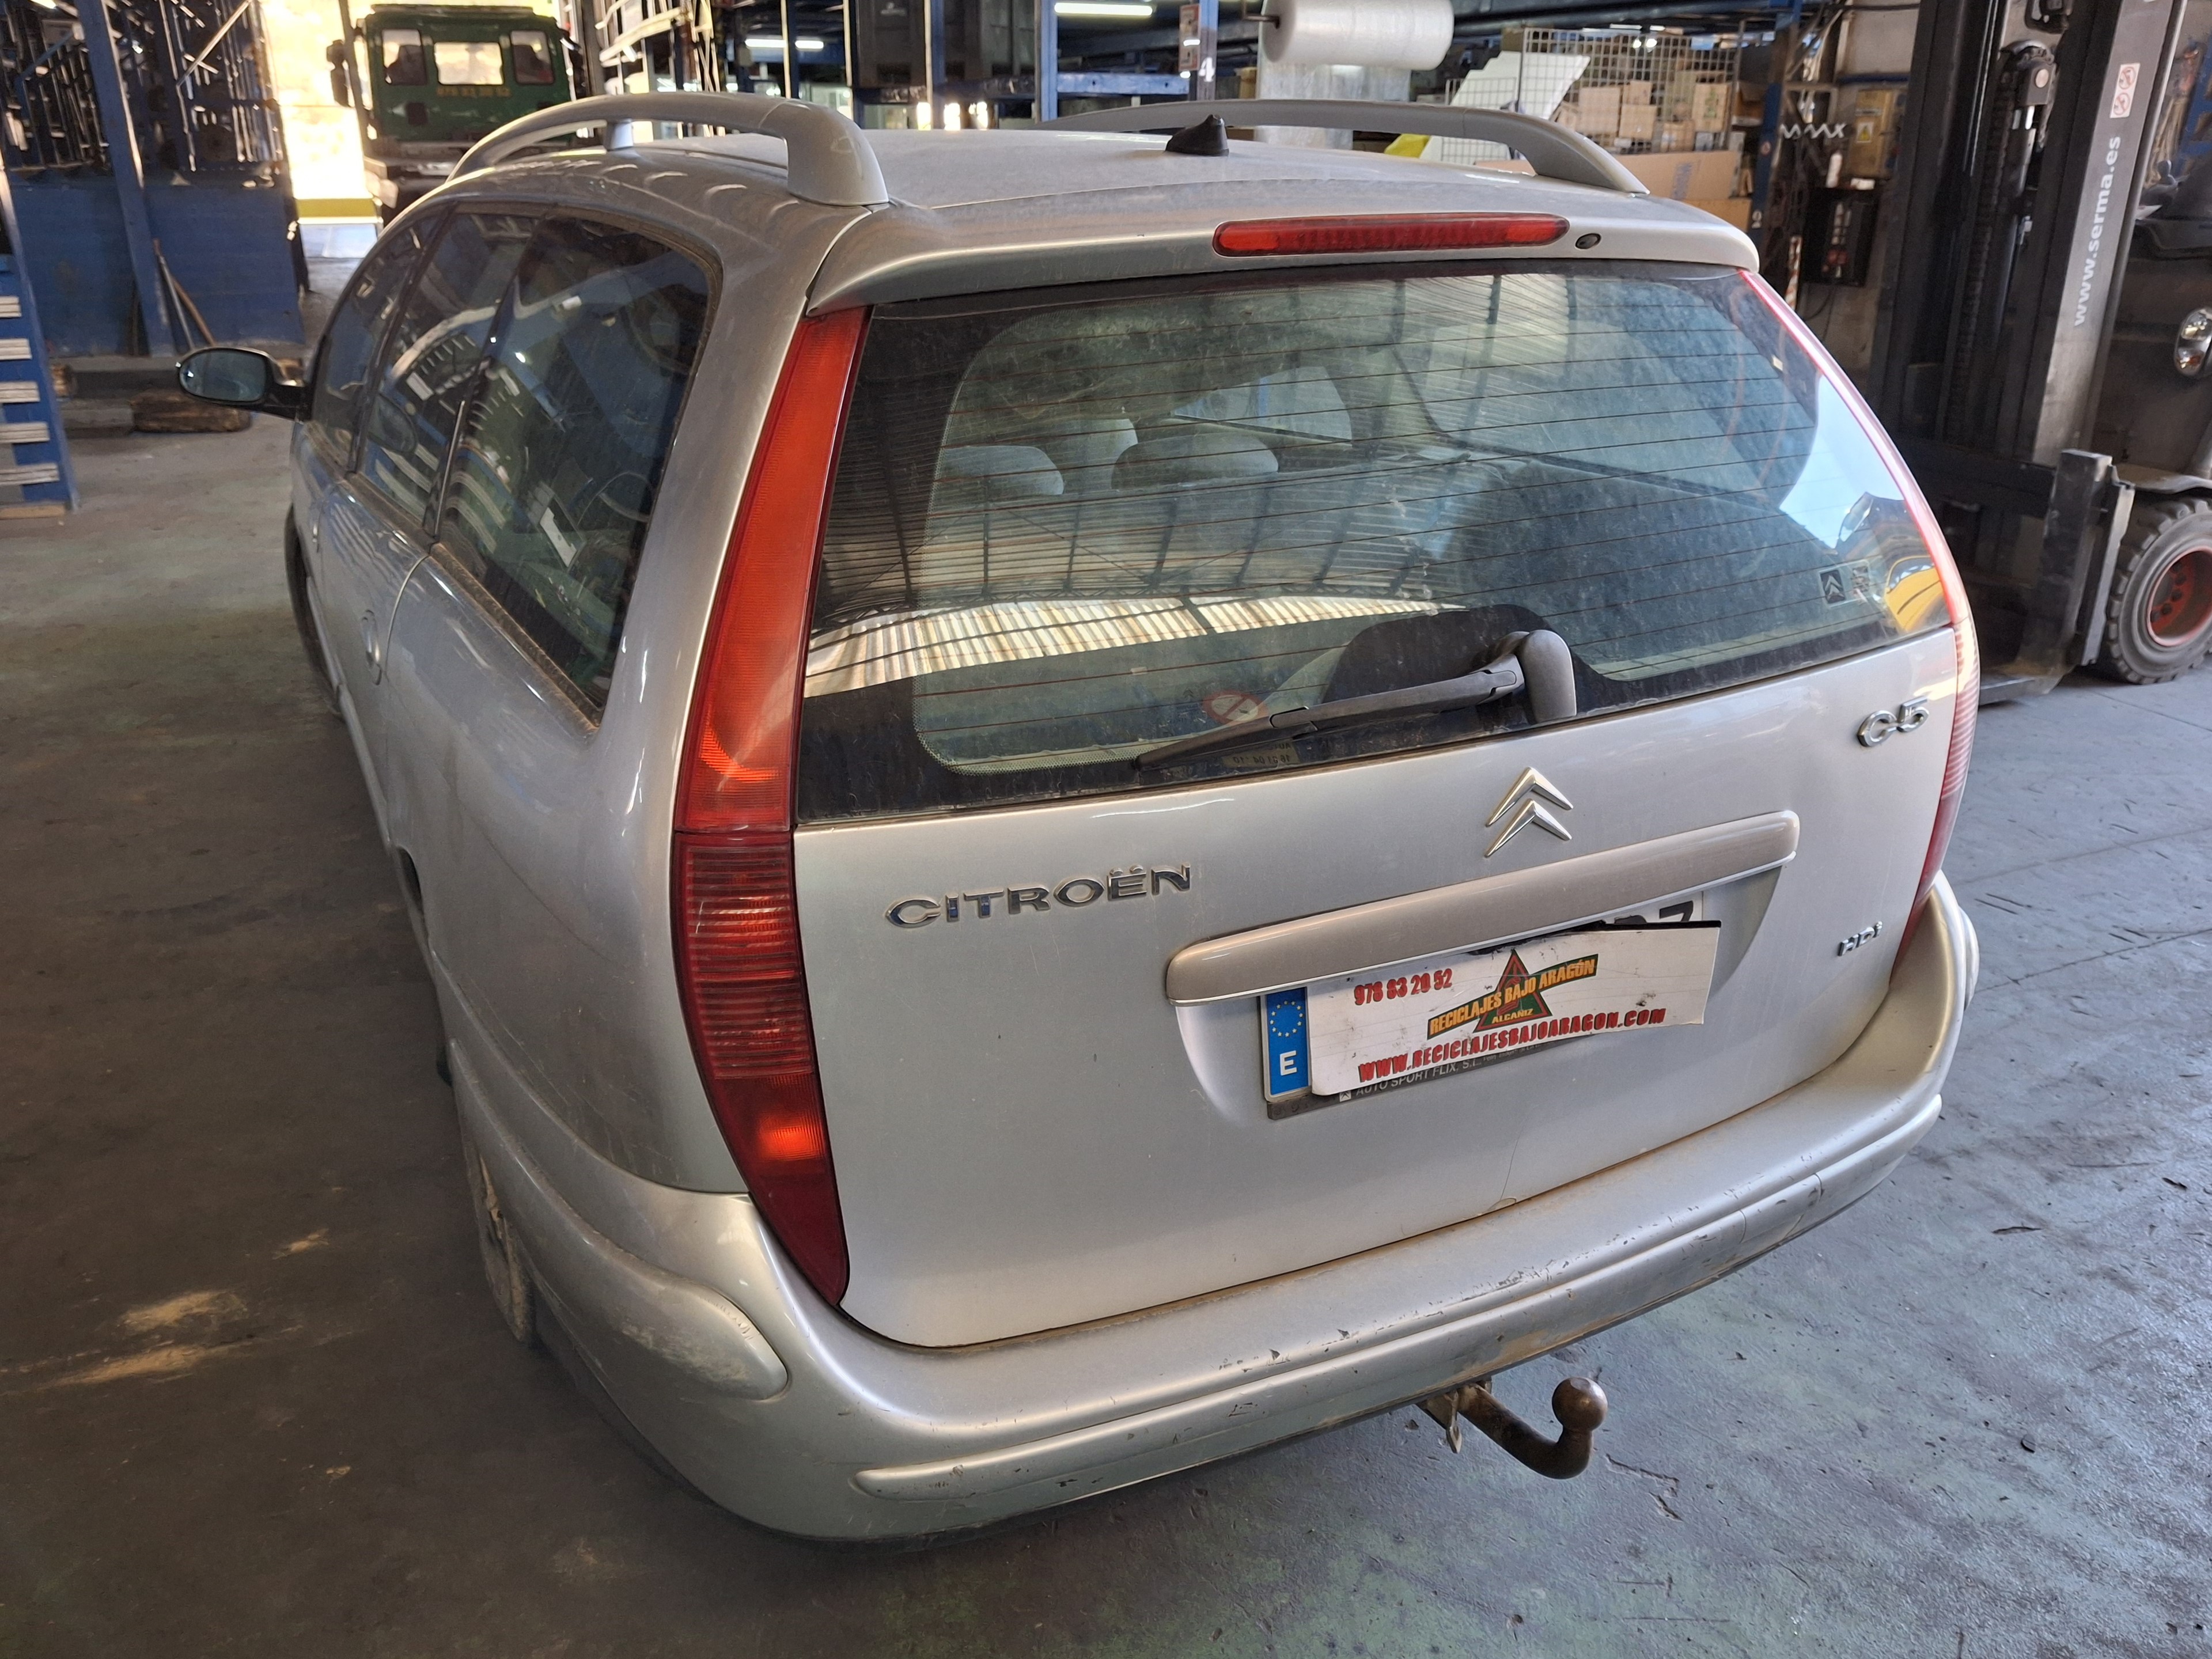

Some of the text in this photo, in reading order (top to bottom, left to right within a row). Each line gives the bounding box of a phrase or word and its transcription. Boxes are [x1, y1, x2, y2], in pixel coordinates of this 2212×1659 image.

[2074, 136, 2121, 326] www.serma.es
[1857, 696, 1929, 747] C5
[886, 863, 1191, 929] CITROËN
[1354, 968, 1453, 1006] 978 83 20 52
[1429, 959, 1596, 1035] RECICLAJES BAJO ARAGÓN
[1280, 1050, 1297, 1076] E
[1358, 1009, 1666, 1083] WWW.RECICLAJESBAJOARAGON.COM
[1390, 1069, 1430, 1088] SPORT
